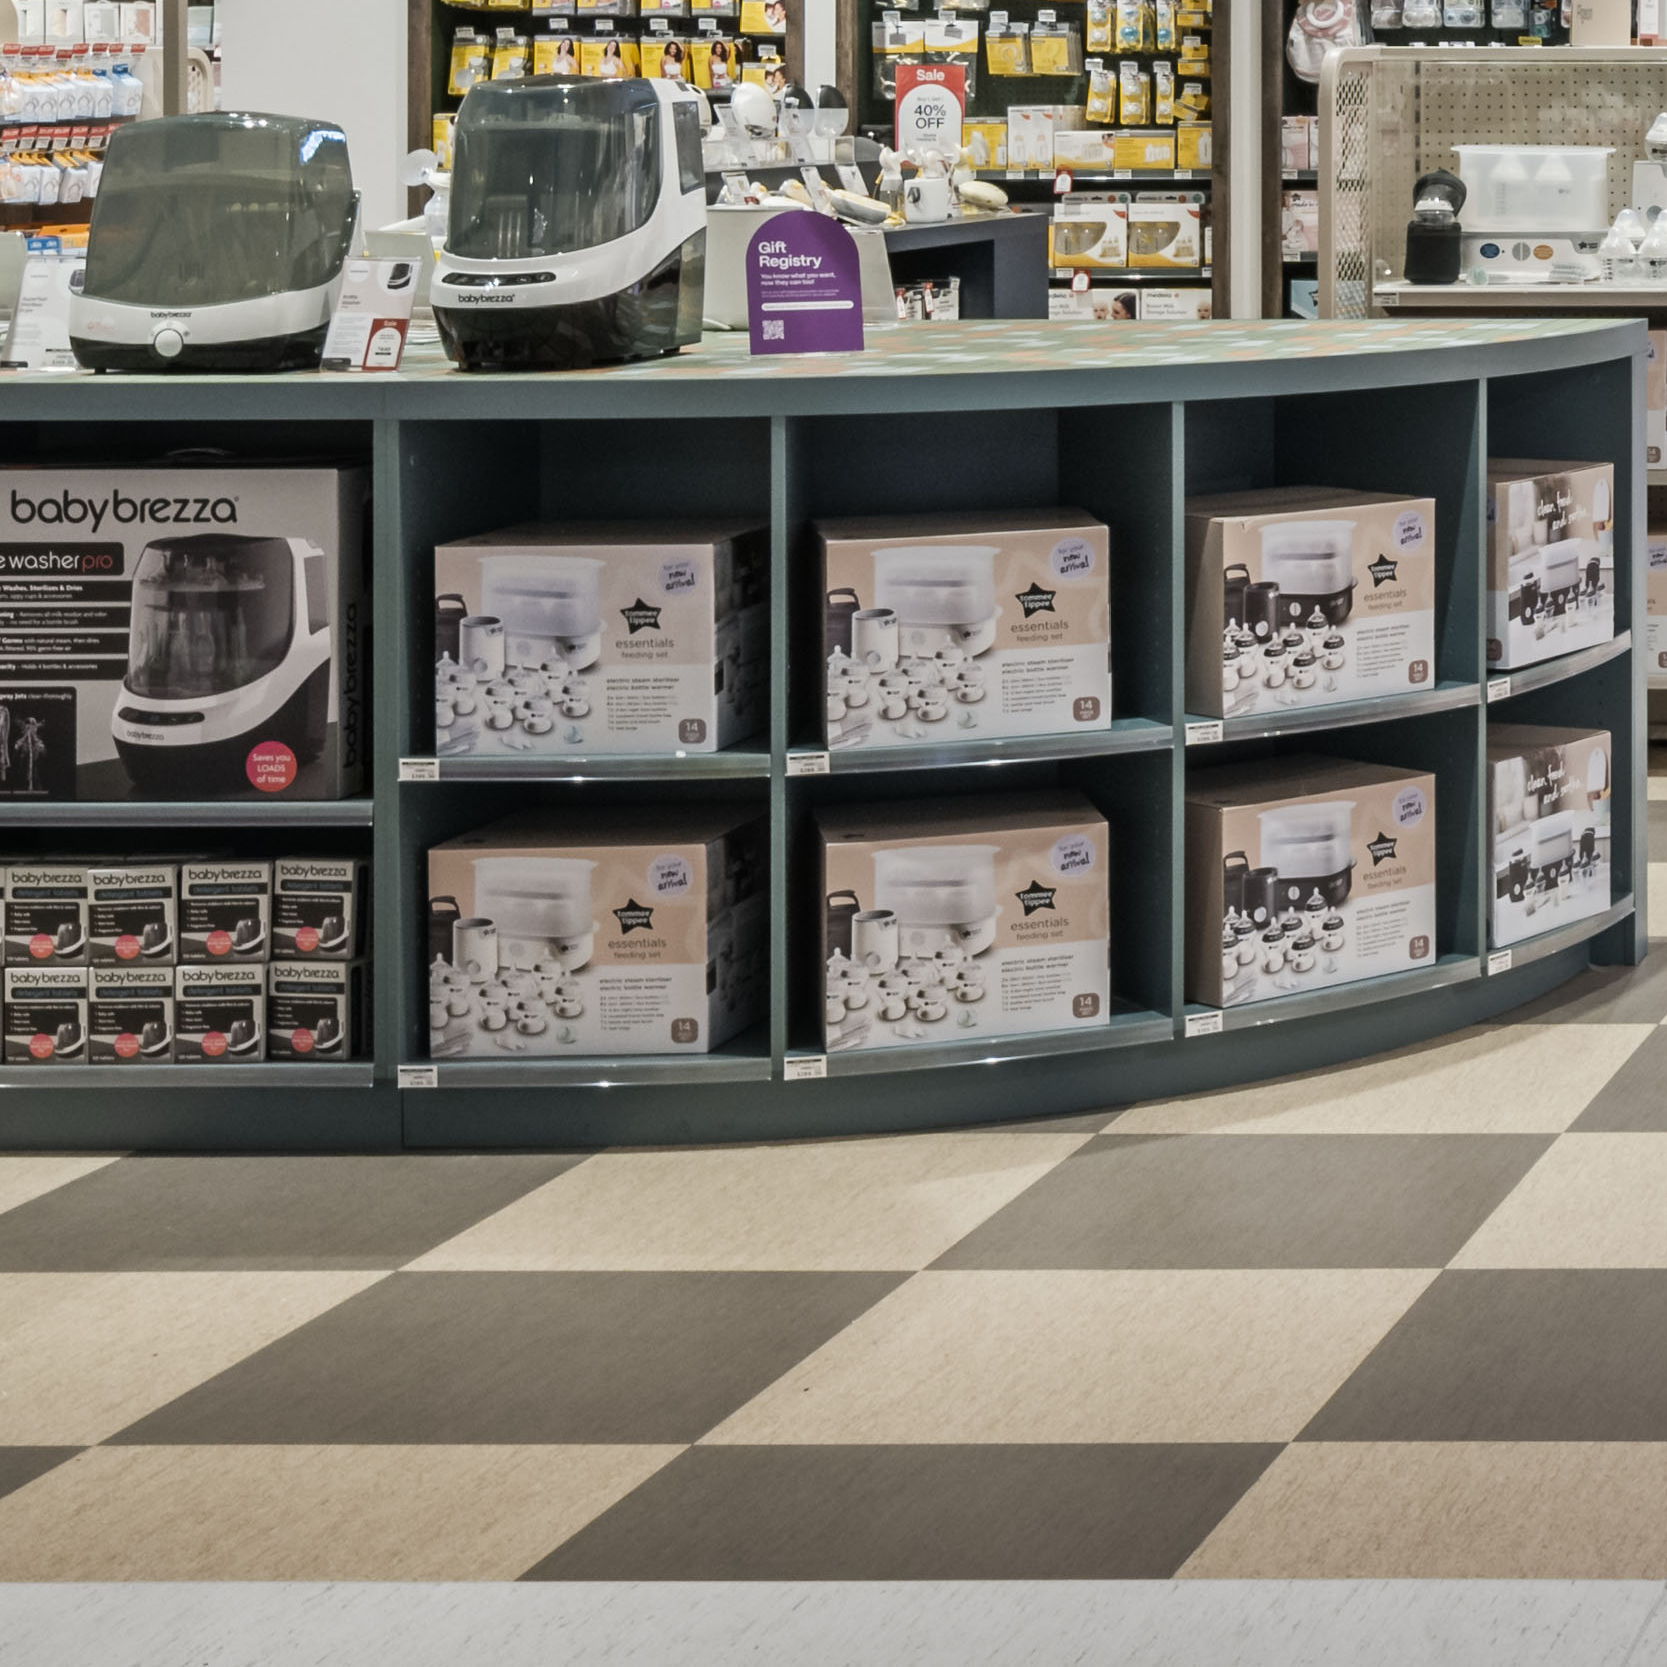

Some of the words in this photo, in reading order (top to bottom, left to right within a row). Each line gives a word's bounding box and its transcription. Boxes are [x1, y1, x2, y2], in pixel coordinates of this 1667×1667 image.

[916, 69, 945, 81] Sale
[914, 104, 946, 116] 40%
[915, 117, 945, 129] OFF
[758, 240, 787, 254] Gift
[759, 254, 822, 270] Registry
[9, 551, 79, 569] washer
[82, 555, 114, 574] pro
[1020, 594, 1052, 602] tommee
[1364, 589, 1407, 602] essentials
[1024, 599, 1050, 609] tippee
[1010, 620, 1069, 633] essentials
[616, 637, 674, 649] essentials
[1016, 634, 1048, 643] feeding
[656, 650, 668, 658] set
[1080, 700, 1092, 710] 14
[686, 722, 698, 731] 14
[253, 753, 273, 762] Saves
[275, 755, 291, 764] you
[257, 764, 286, 773] LOADS
[257, 775, 265, 783] of
[268, 775, 286, 783] time
[1363, 866, 1407, 881] essentials
[1010, 917, 1069, 931] essentials
[608, 938, 667, 950] essentials
[614, 951, 646, 960] feeding
[1080, 997, 1092, 1007] 14
[679, 1021, 690, 1031] 14
